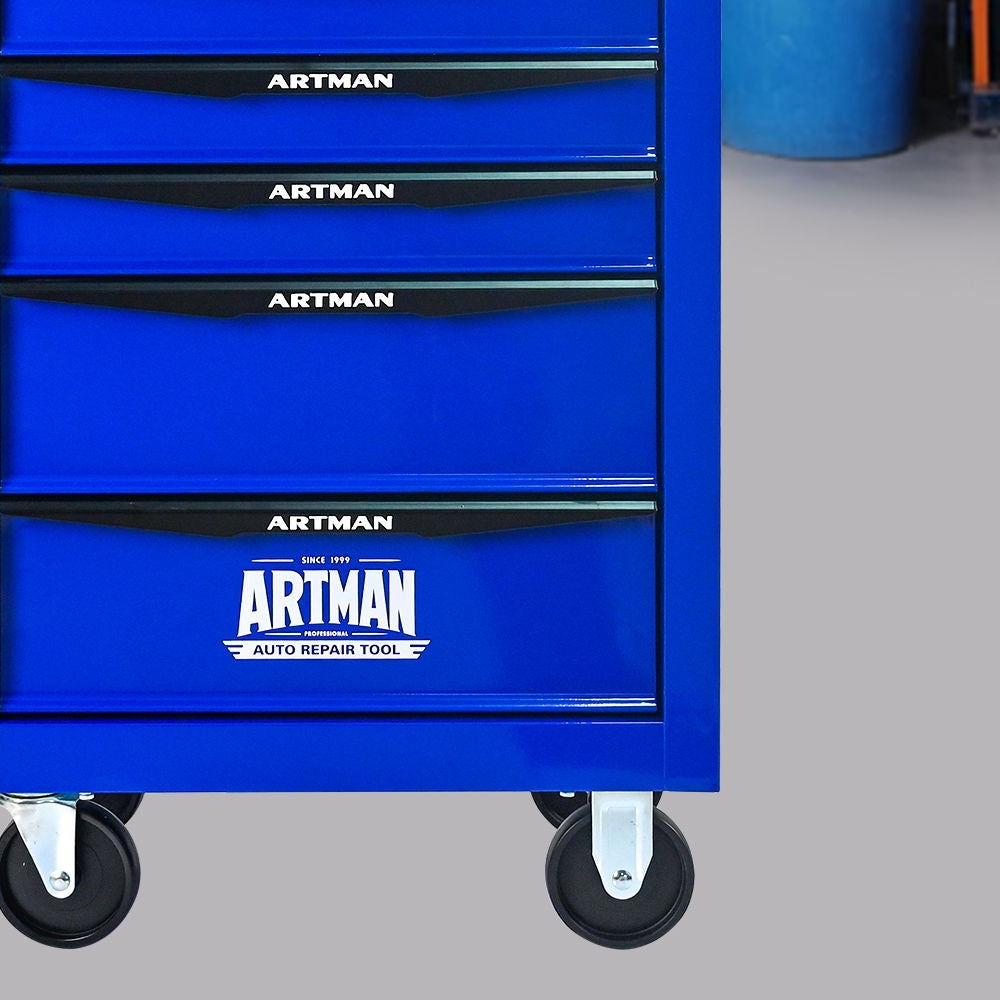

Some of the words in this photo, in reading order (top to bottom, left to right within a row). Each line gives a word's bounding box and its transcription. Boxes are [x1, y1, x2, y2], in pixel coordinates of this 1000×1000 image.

[267, 73, 393, 89] ARTMAN
[268, 184, 394, 199] ARTMAN
[268, 292, 394, 308] ARTMAN
[267, 515, 393, 530] ARTMAN
[301, 556, 326, 564] SINCE
[330, 556, 351, 564] 1999
[237, 570, 416, 637] ARTMAN
[253, 644, 296, 655] AUTO
[301, 644, 355, 655] REPAIR
[360, 644, 401, 655] TOOL
